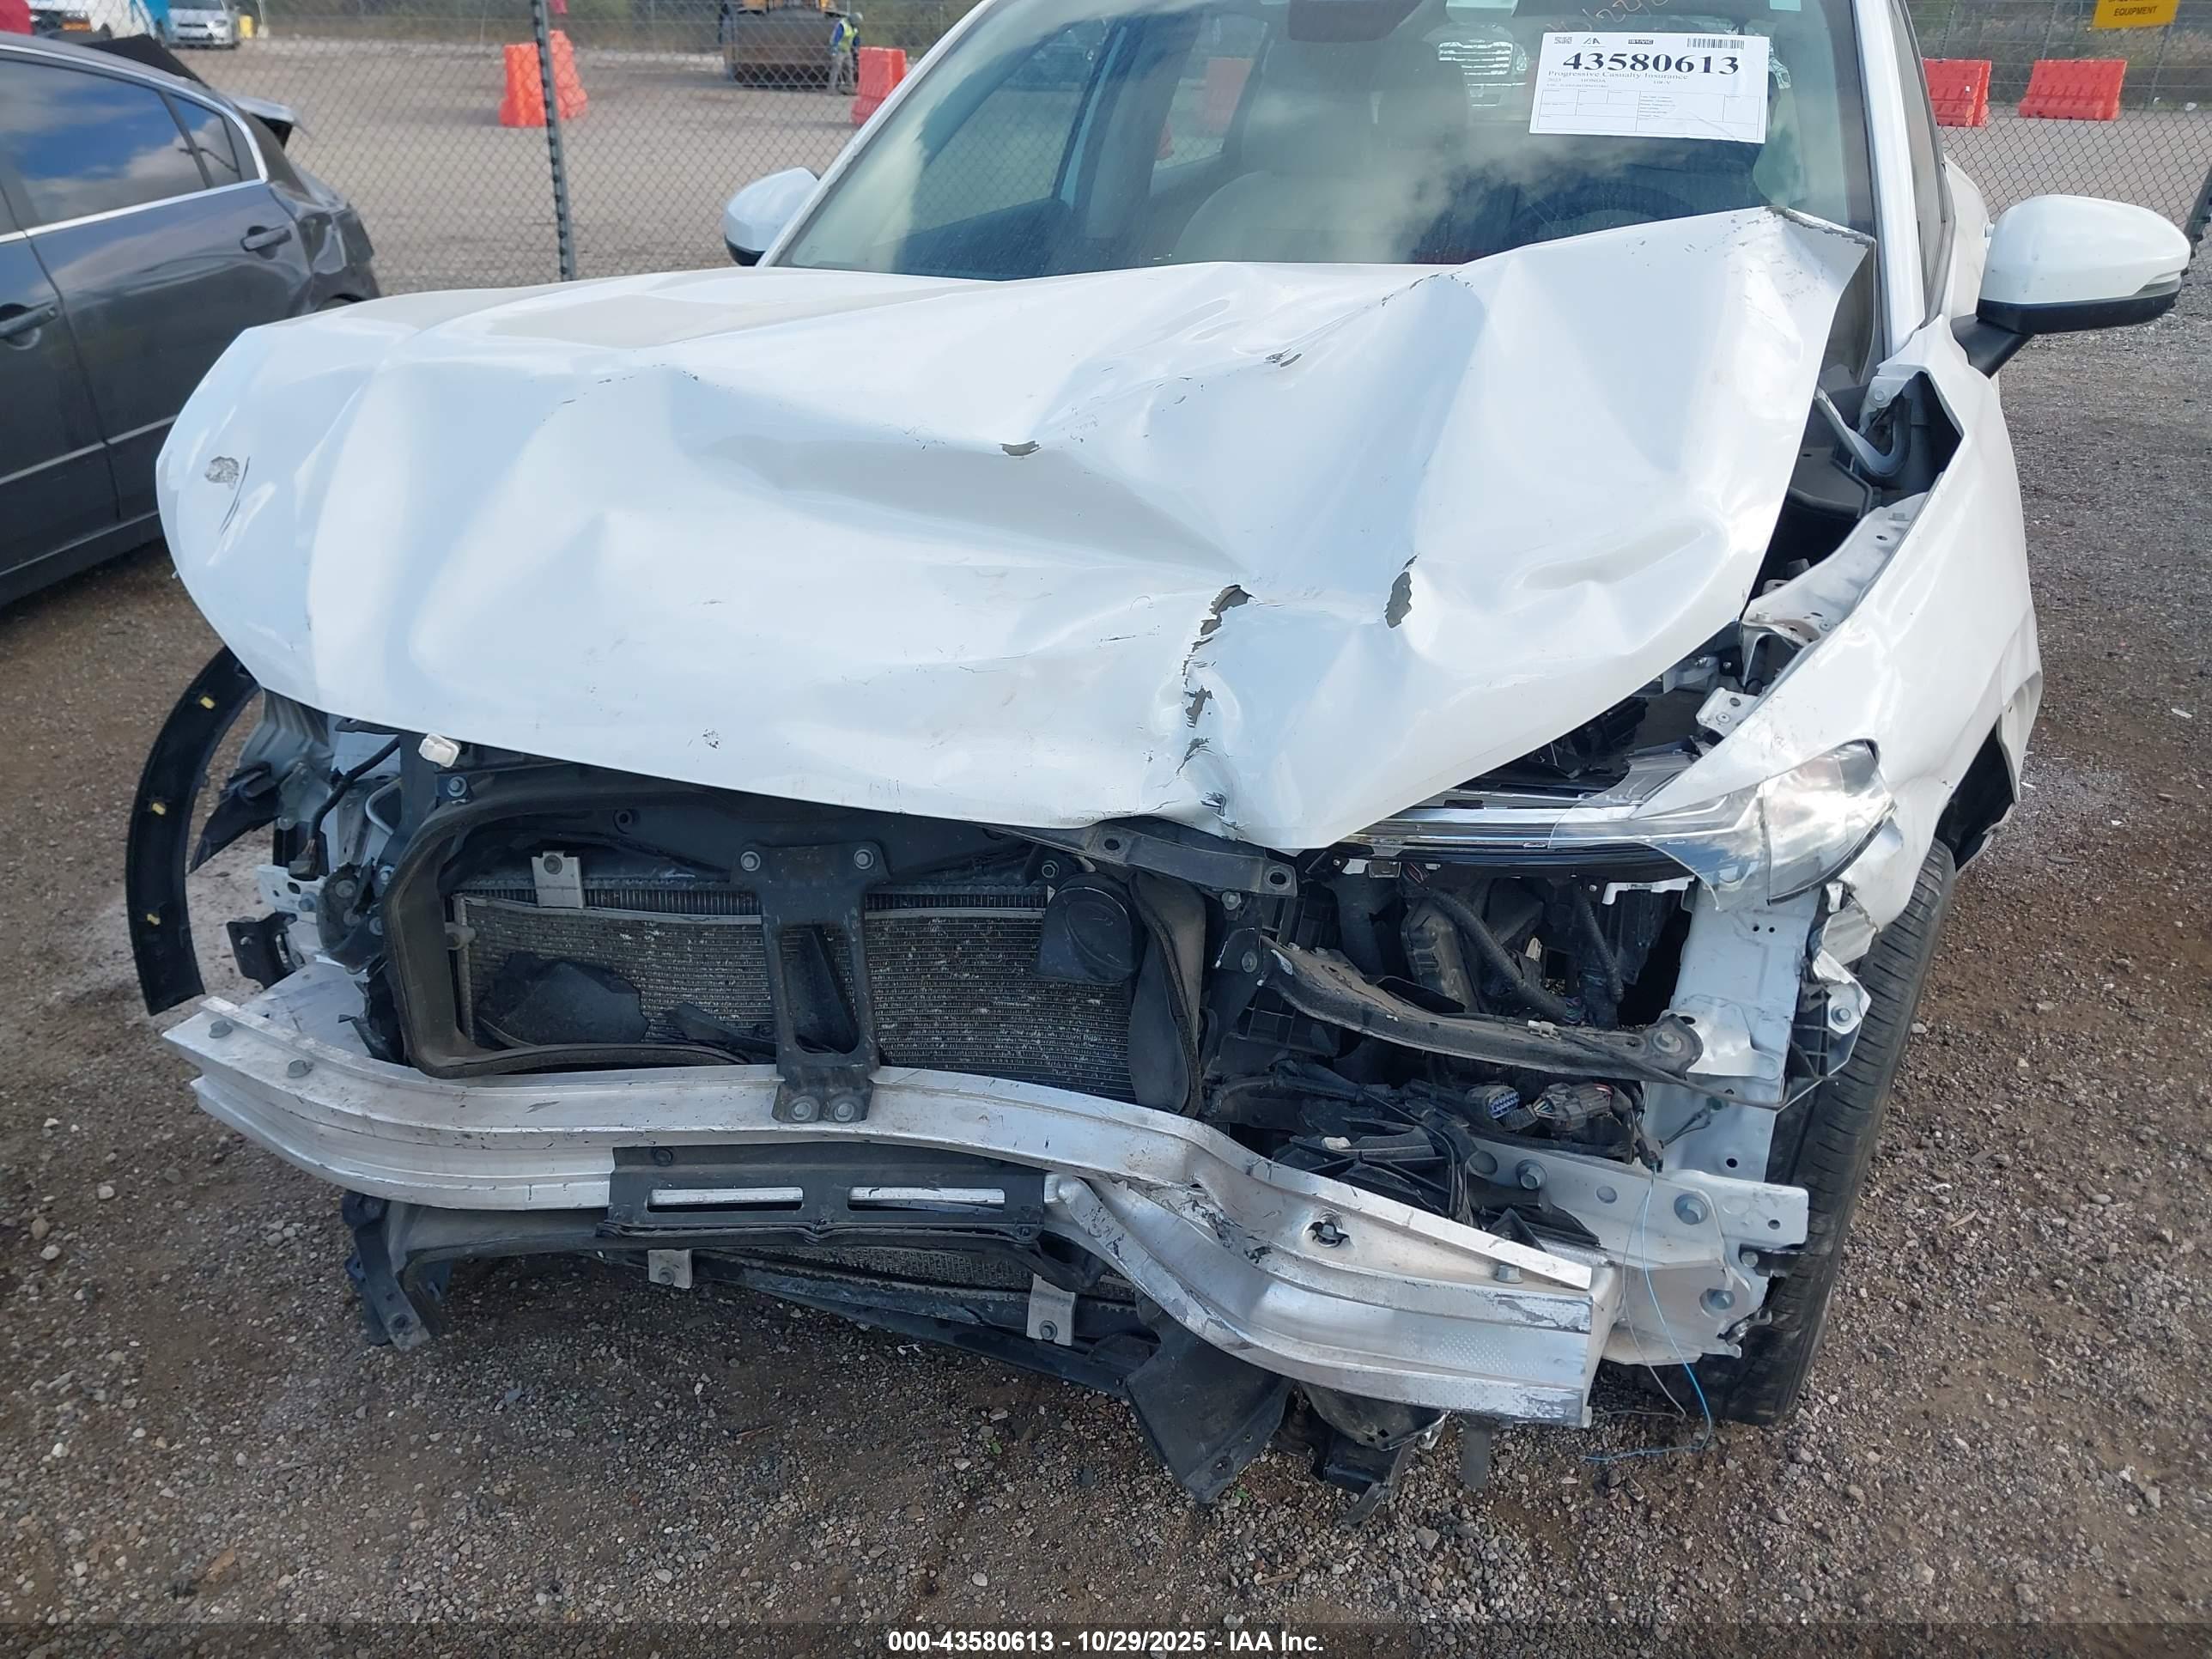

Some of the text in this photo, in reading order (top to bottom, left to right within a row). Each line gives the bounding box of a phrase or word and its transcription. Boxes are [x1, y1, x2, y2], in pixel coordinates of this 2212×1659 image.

[2113, 5, 2158, 16] EQUIPMENT
[1563, 52, 1739, 76] 43580613
[1547, 70, 1600, 79] Progressive
